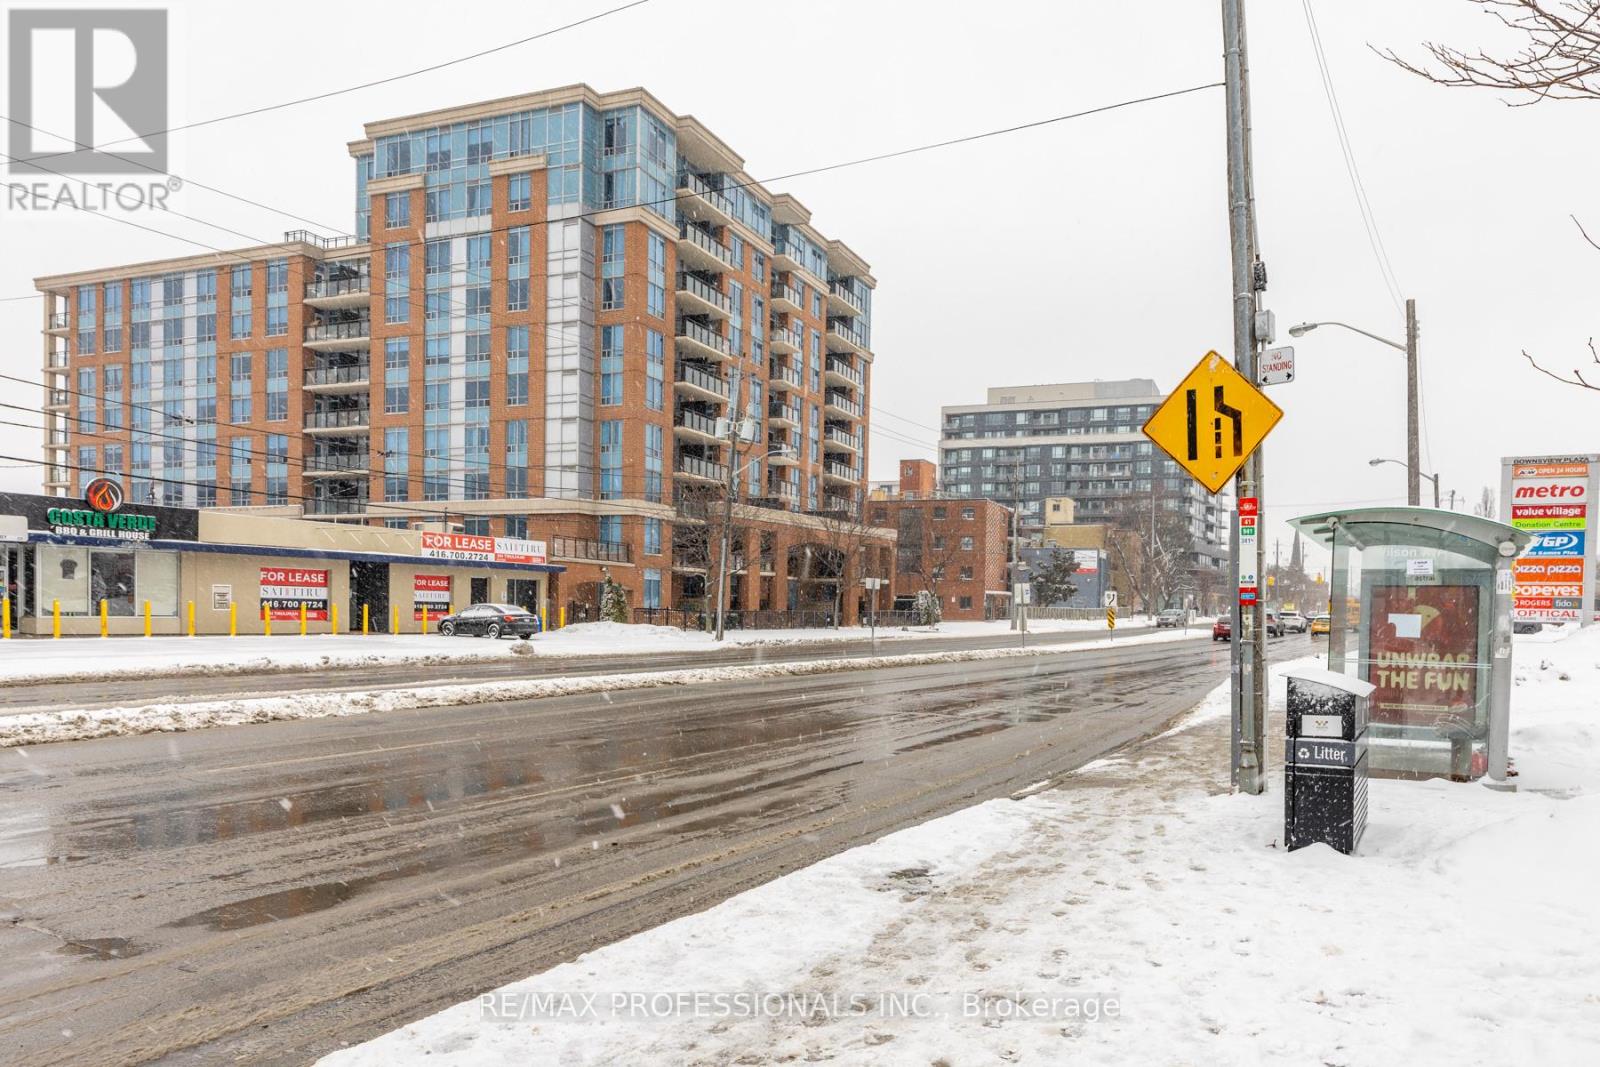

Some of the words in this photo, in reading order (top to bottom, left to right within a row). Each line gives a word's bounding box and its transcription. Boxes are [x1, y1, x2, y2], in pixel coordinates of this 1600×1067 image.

[1272, 351, 1282, 360] NO
[1262, 360, 1292, 373] STANDING
[1515, 484, 1585, 498] metro
[1516, 508, 1545, 516] value
[1546, 506, 1581, 517] village
[47, 507, 104, 527] COSTA
[106, 513, 156, 531] VERDE
[1553, 520, 1582, 528] Centre
[55, 526, 78, 536] BBQ
[79, 528, 88, 536] &
[88, 528, 117, 538] GRILL
[118, 530, 151, 540] HOUSE
[426, 535, 452, 548] FOR
[455, 537, 492, 550] LEASE
[429, 550, 489, 561] 416.700.2724
[1547, 565, 1582, 575] pizza
[260, 571, 286, 582] FOR
[288, 573, 325, 583] LEASE
[1517, 610, 1579, 618] OPTICAL
[1376, 652, 1470, 669] UNWRAP
[1376, 671, 1418, 690] THE
[1424, 672, 1470, 692] FUN
[1314, 746, 1346, 761] Litter
